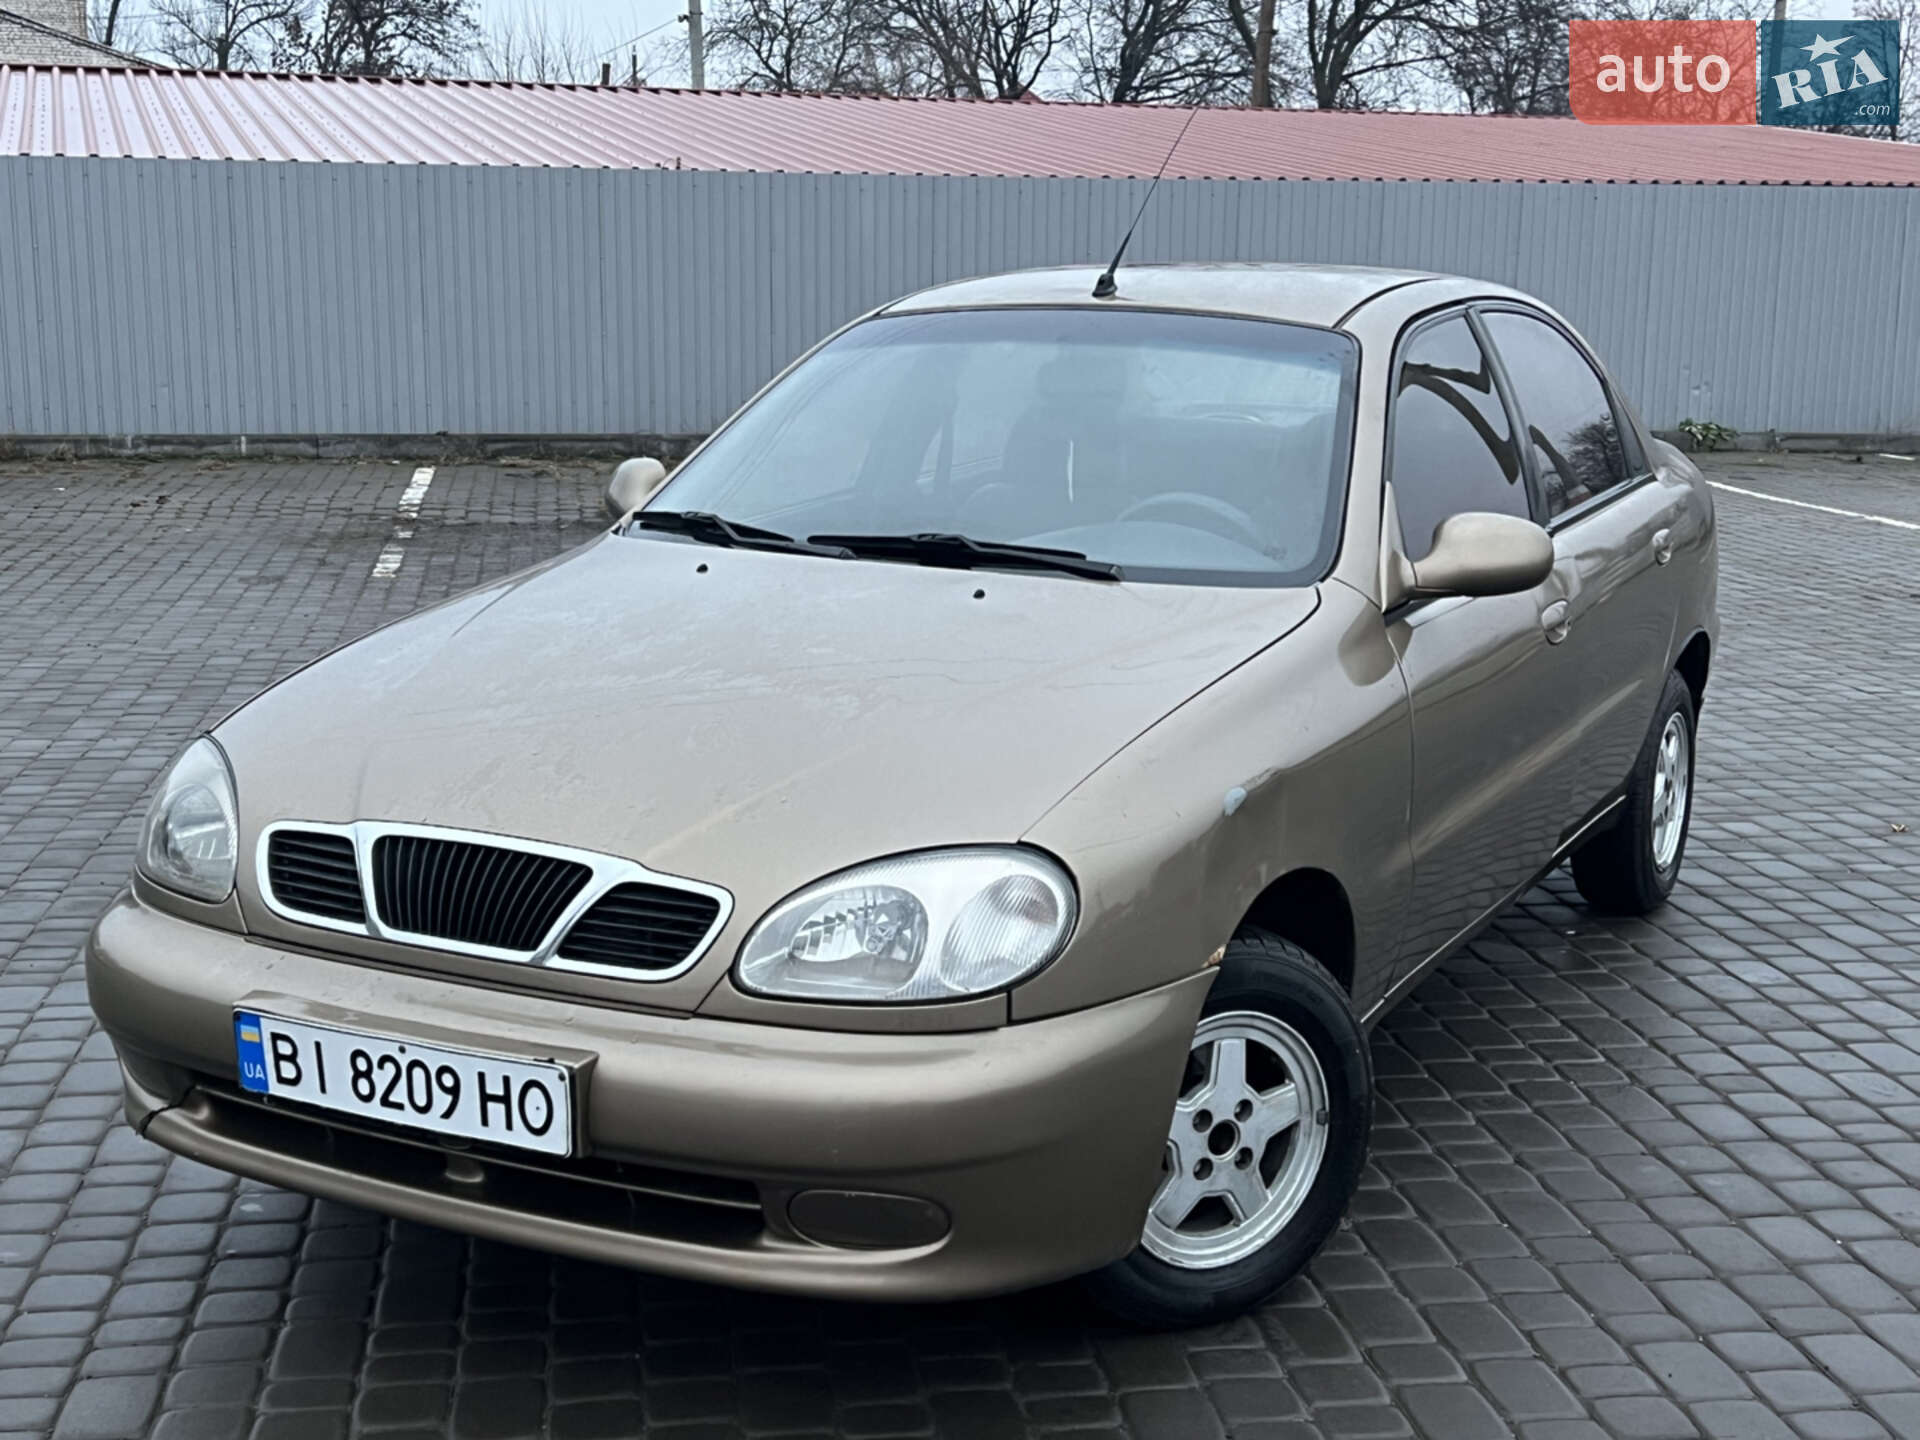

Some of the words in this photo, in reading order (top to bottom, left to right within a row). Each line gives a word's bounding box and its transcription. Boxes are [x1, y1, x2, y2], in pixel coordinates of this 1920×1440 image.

[243, 1063, 266, 1081] UA
[270, 1031, 327, 1095] BI
[349, 1048, 461, 1120] 8209
[477, 1071, 554, 1137] HO
